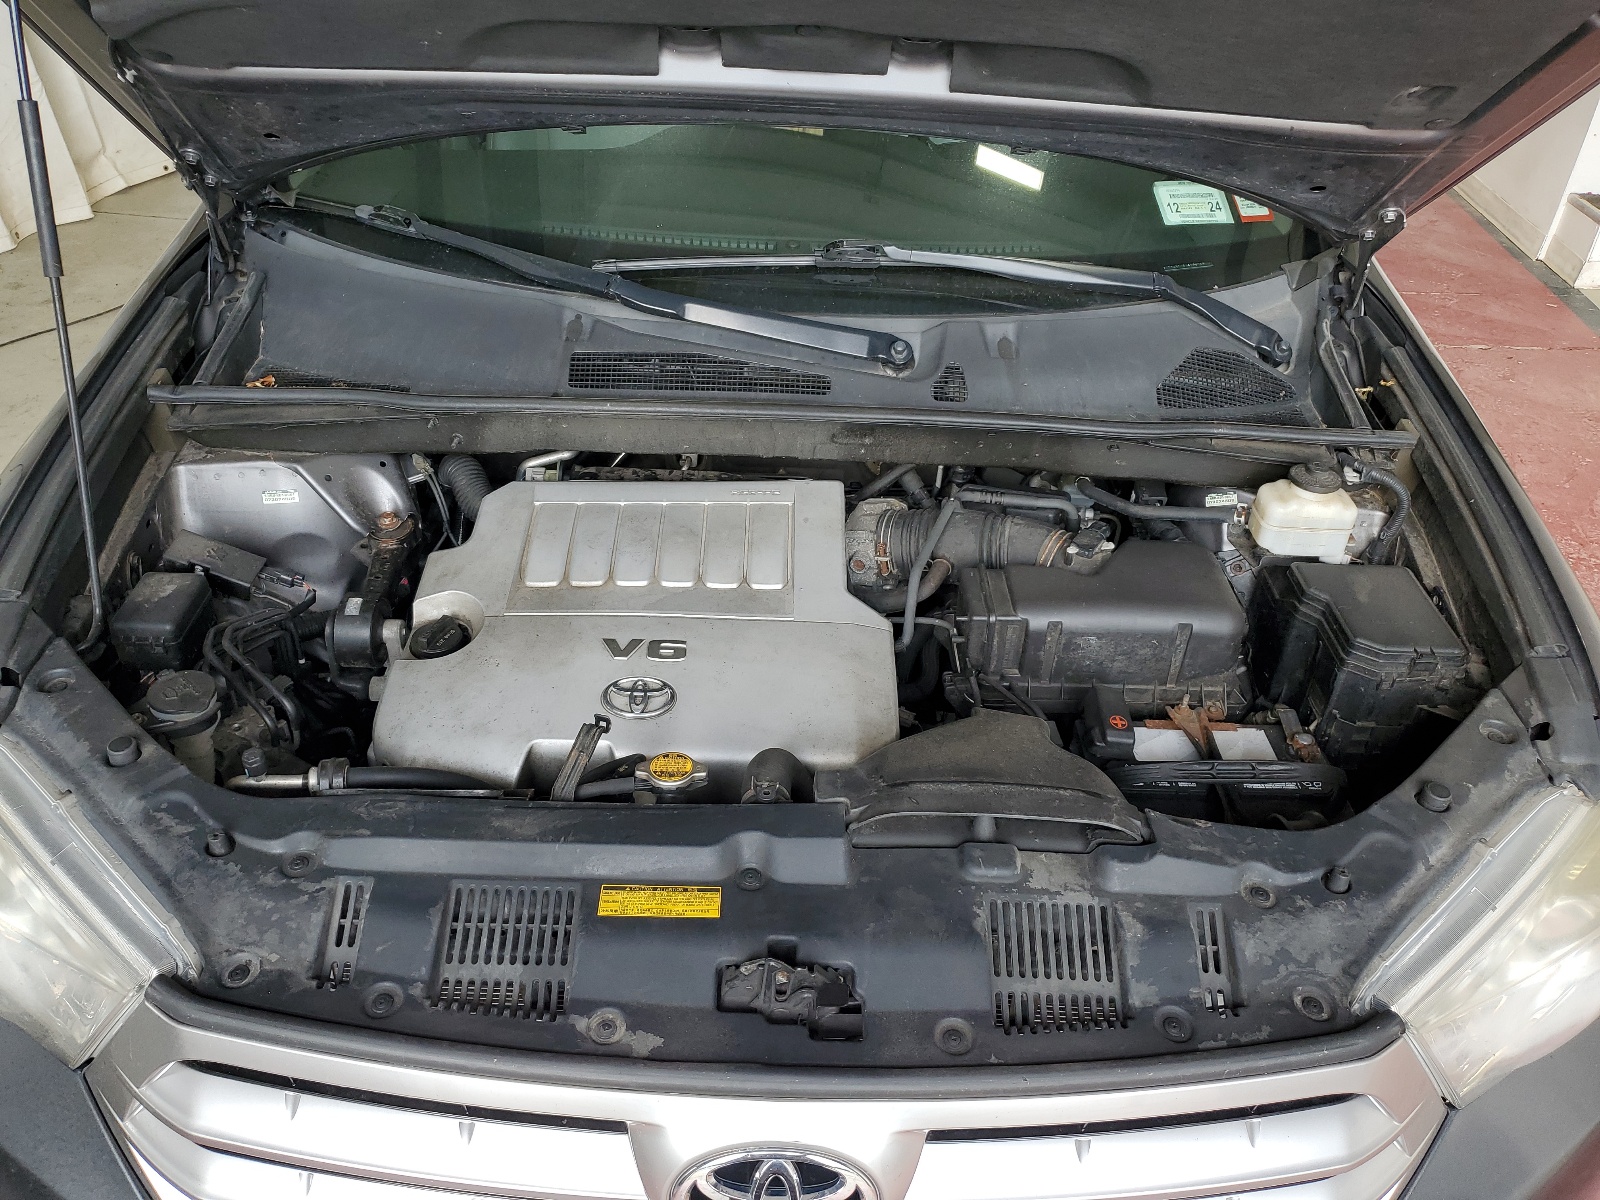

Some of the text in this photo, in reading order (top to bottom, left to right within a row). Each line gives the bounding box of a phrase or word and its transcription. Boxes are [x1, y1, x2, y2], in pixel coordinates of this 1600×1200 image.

[1166, 202, 1181, 214] 12
[1207, 200, 1222, 213] 24
[601, 637, 687, 662] V6
